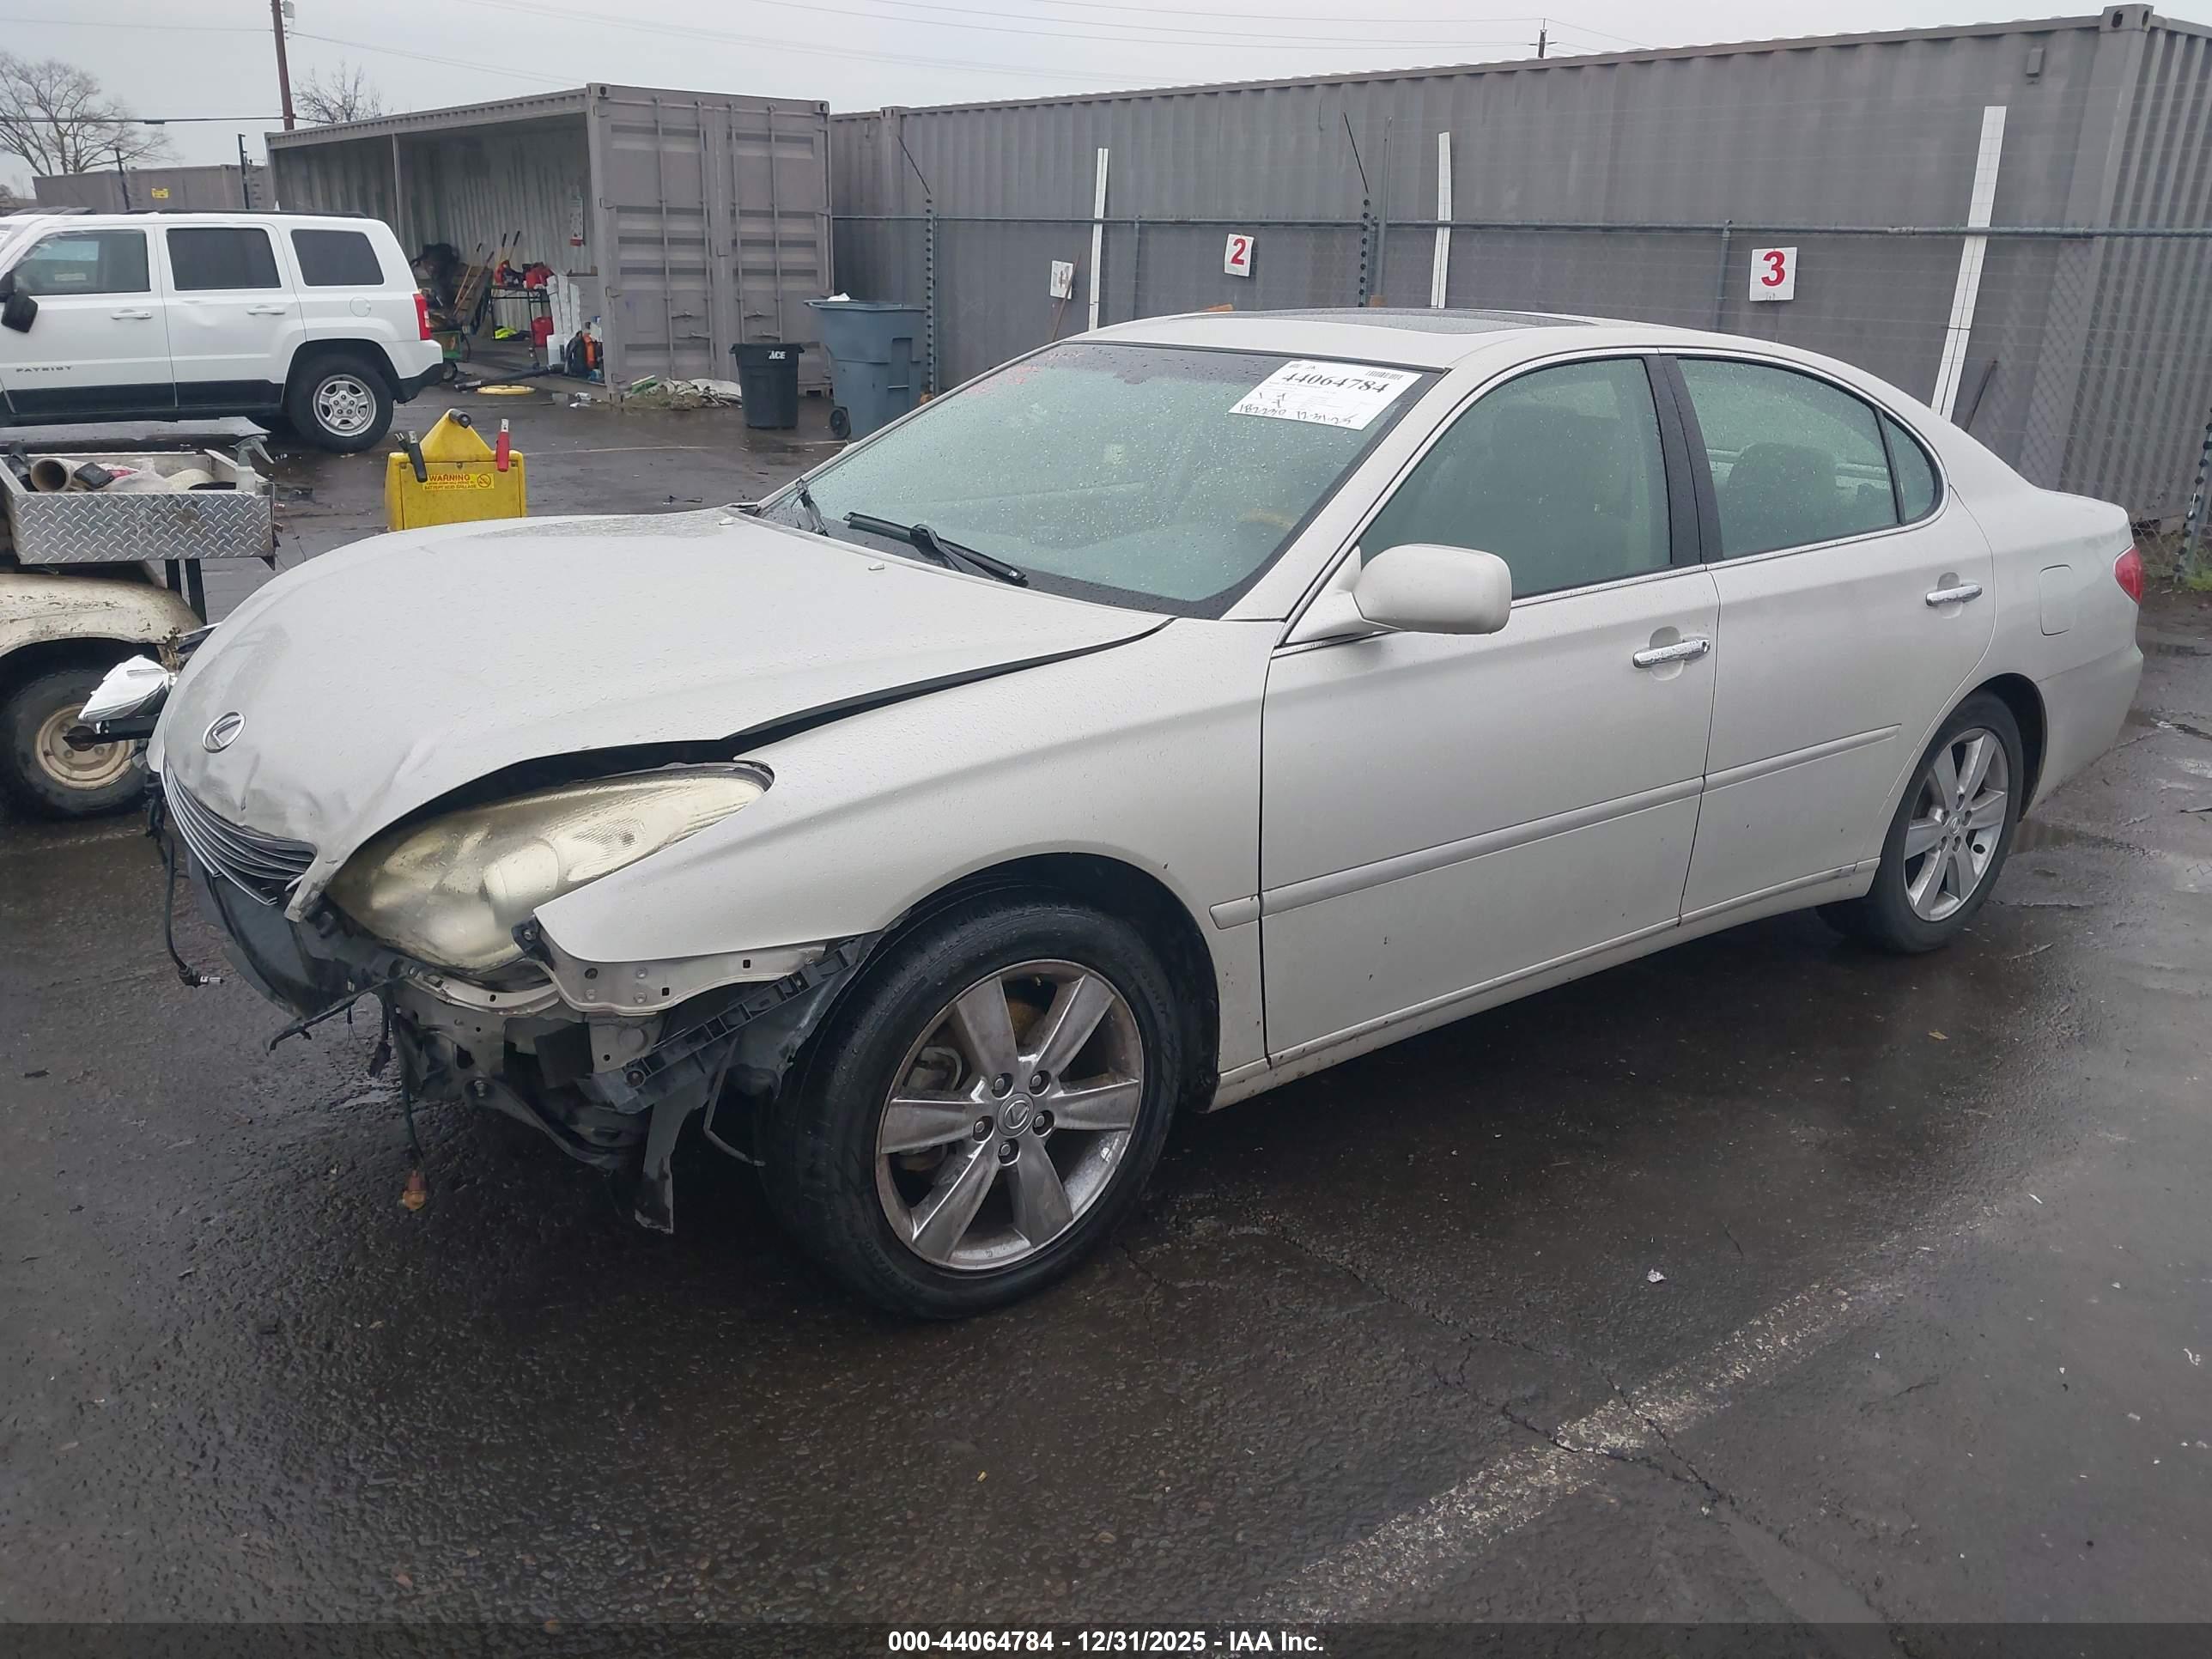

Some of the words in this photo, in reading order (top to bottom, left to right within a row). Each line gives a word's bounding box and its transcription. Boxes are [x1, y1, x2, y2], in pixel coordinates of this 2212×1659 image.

[1231, 239, 1246, 265] 2
[1761, 251, 1785, 287] 3
[768, 350, 786, 359] ACE
[1281, 373, 1390, 392] 44064784
